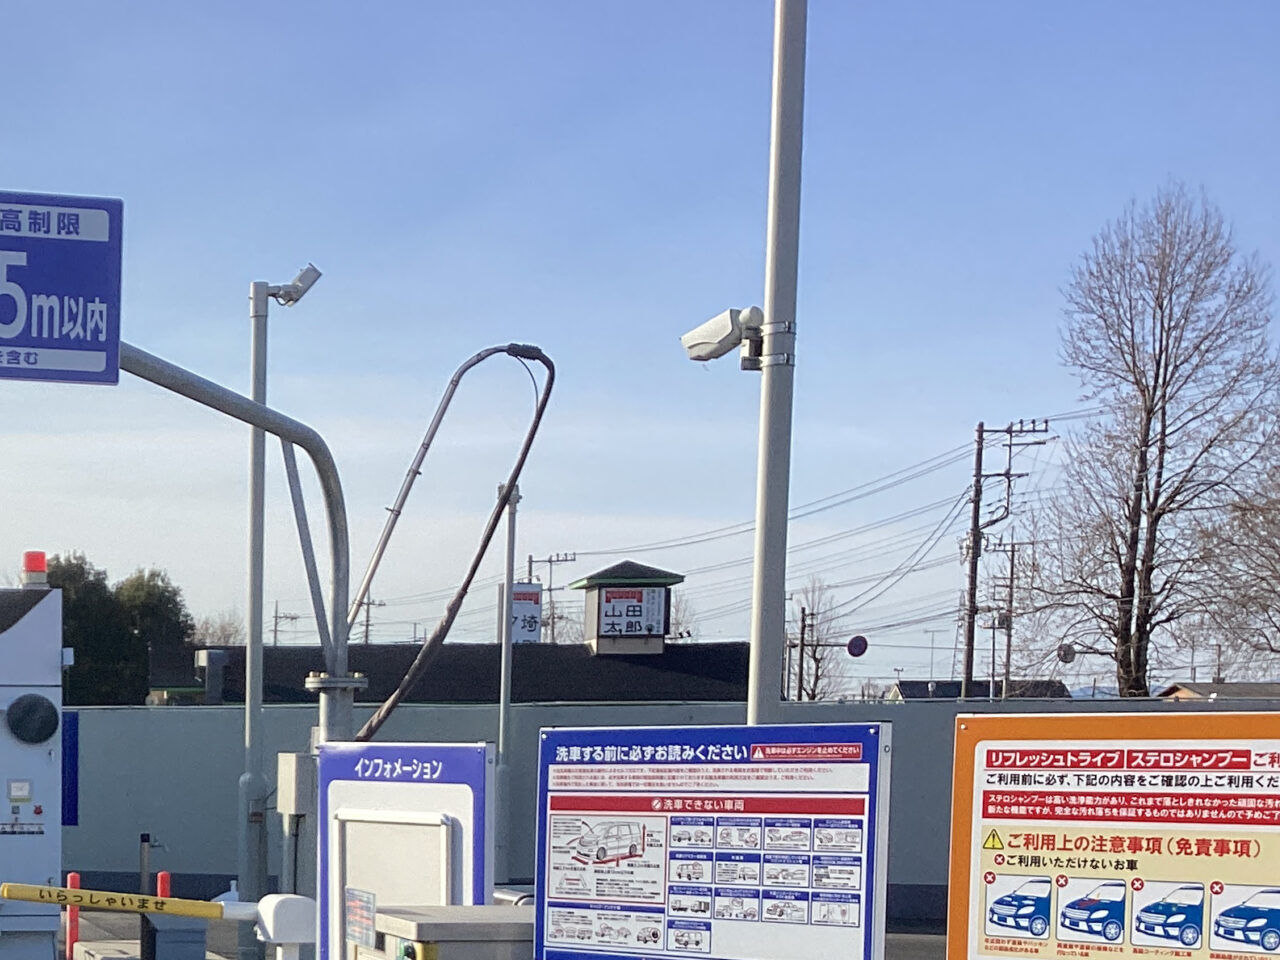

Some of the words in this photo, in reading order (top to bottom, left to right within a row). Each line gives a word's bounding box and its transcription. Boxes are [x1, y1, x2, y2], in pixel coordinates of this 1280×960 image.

[603, 620, 643, 634] 太郎
[555, 745, 748, 762] 洗車する前に必ずお読みください
[991, 752, 1121, 767] リフレッシュトライブ
[1131, 752, 1248, 768] ステロシャンプー
[355, 757, 443, 780] インフォメーション
[663, 798, 745, 812] 洗車できない車両
[1006, 855, 1139, 871] ご利用いただけないお車
[39, 888, 167, 911] いらっしゃいませ
